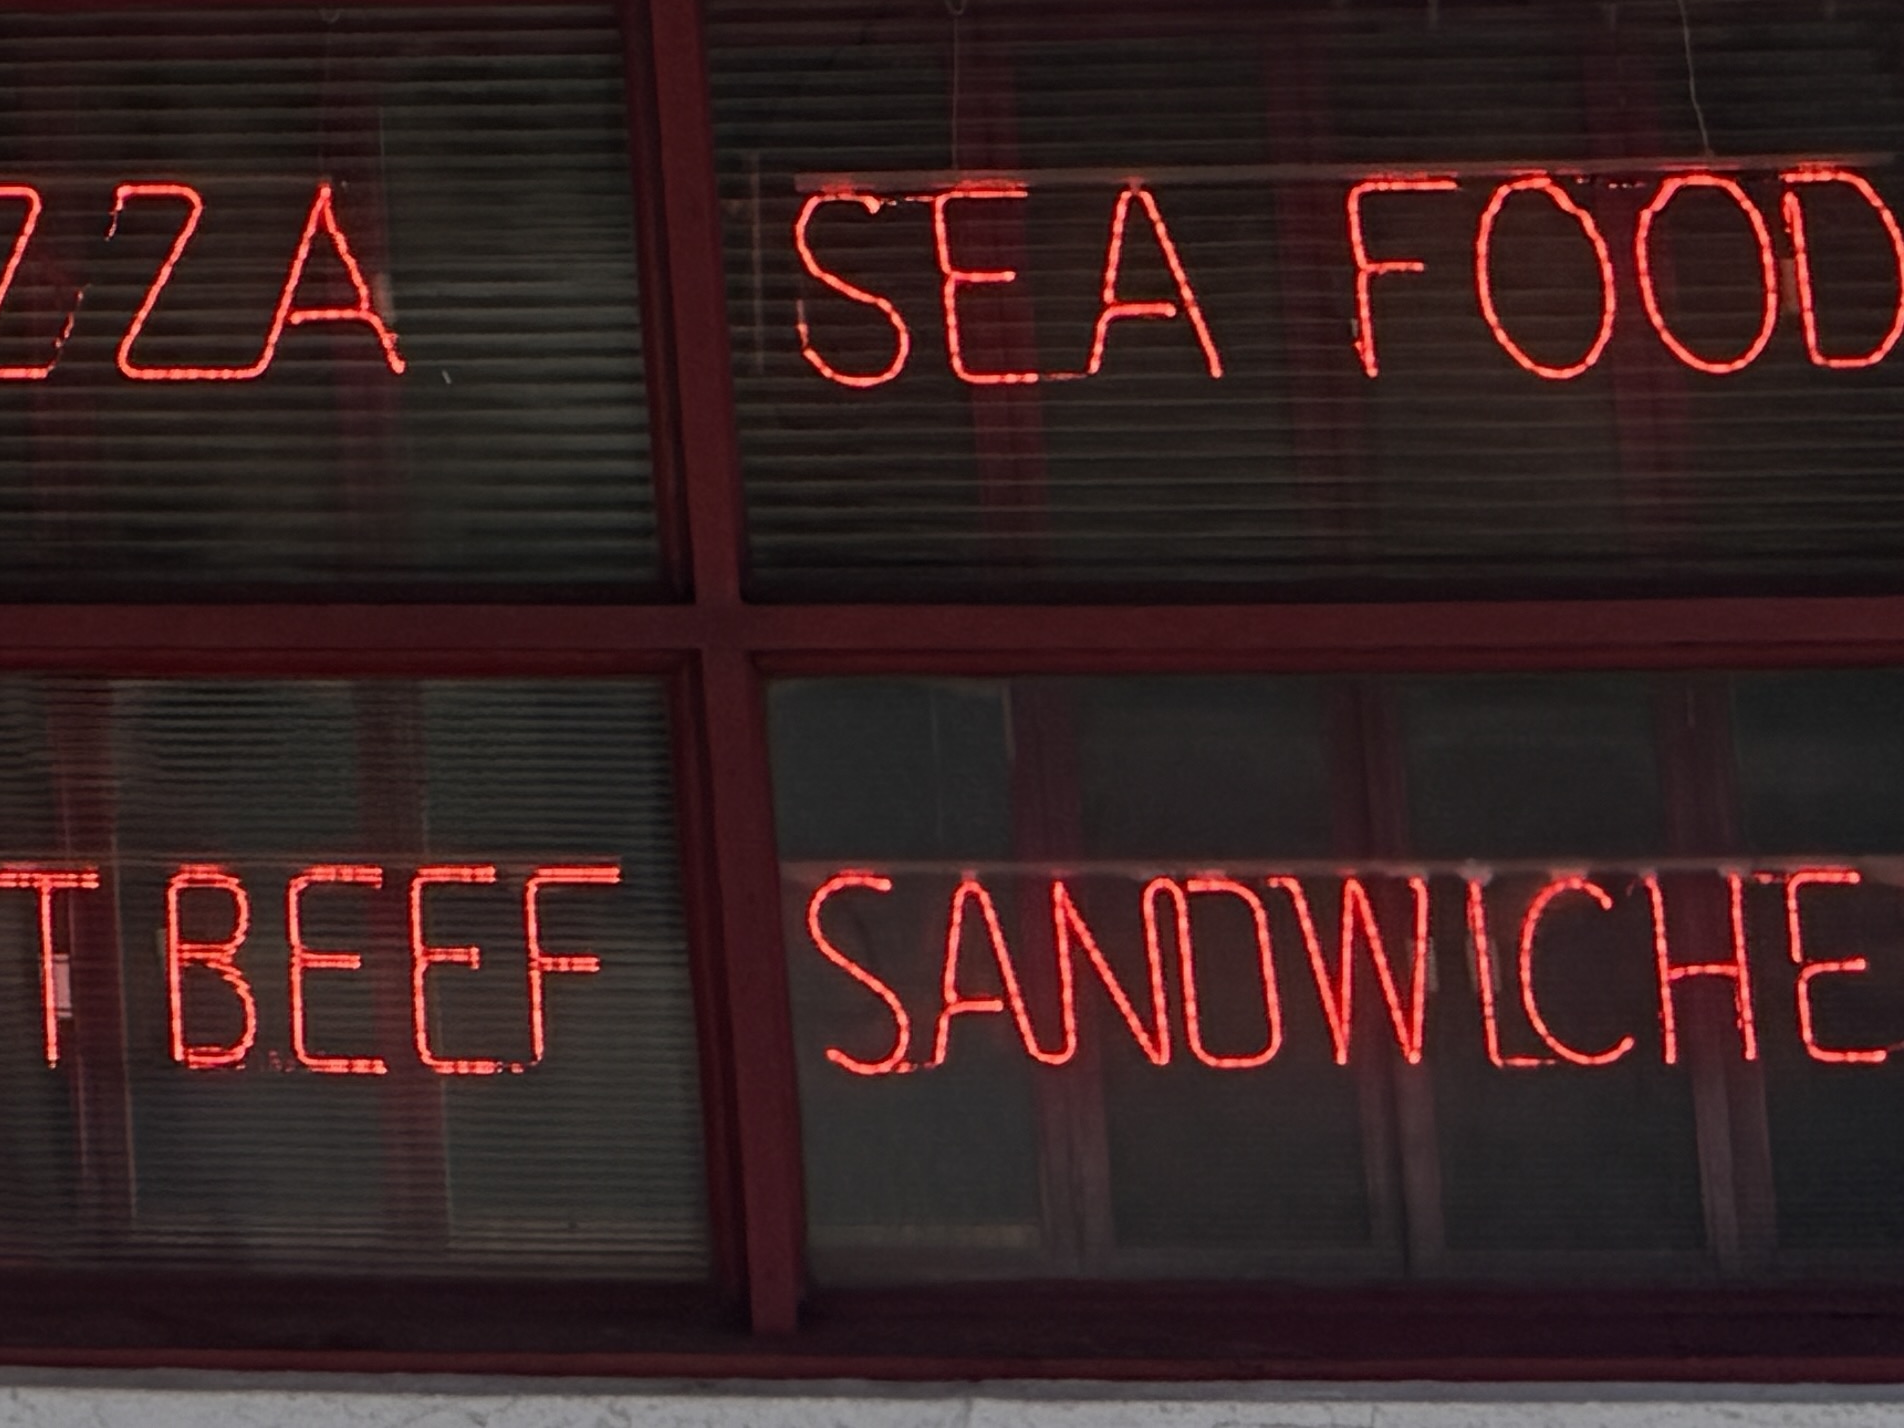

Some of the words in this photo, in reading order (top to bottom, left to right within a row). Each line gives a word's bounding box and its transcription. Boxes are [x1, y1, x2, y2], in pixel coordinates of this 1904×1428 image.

[794, 181, 1223, 387] SEA
[1347, 166, 1904, 380] FOOD
[164, 862, 620, 1074] BEEF
